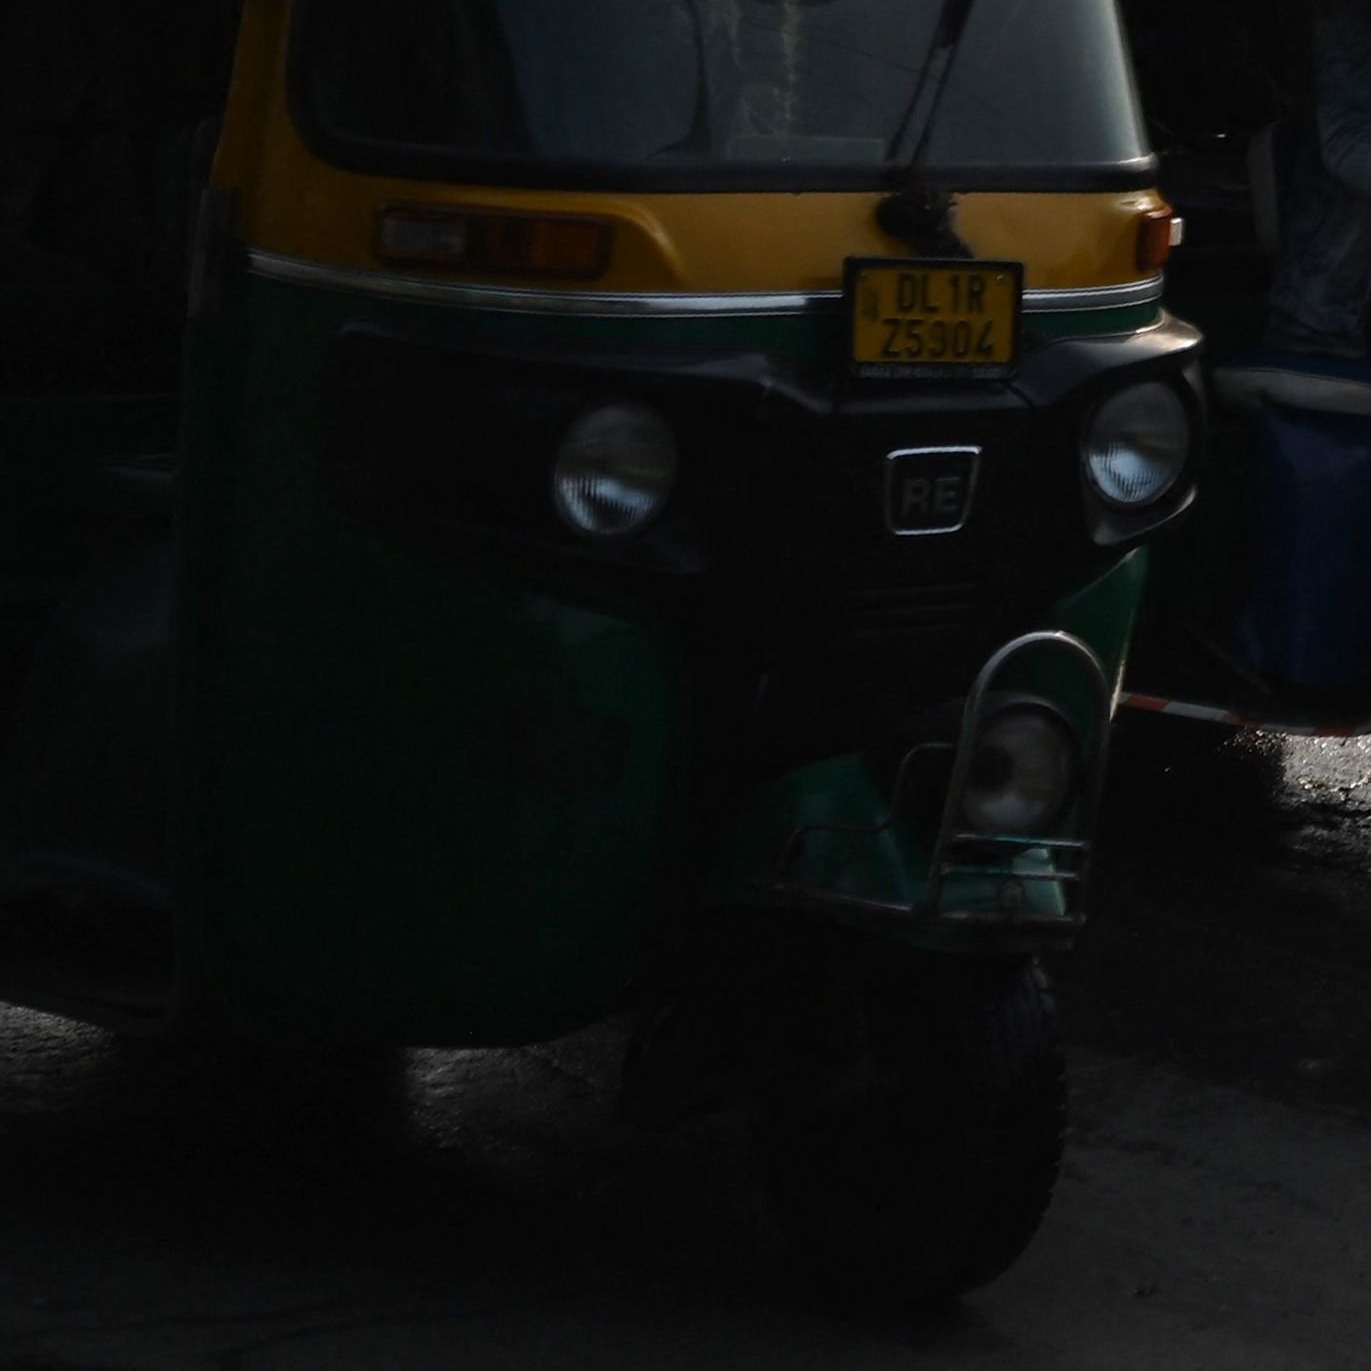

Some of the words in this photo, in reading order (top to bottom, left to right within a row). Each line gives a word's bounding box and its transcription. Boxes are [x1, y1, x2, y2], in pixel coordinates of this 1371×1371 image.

[896, 273, 941, 314] DL
[947, 273, 985, 314] 1R
[881, 317, 994, 359] Z5904
[901, 475, 962, 516] RE
